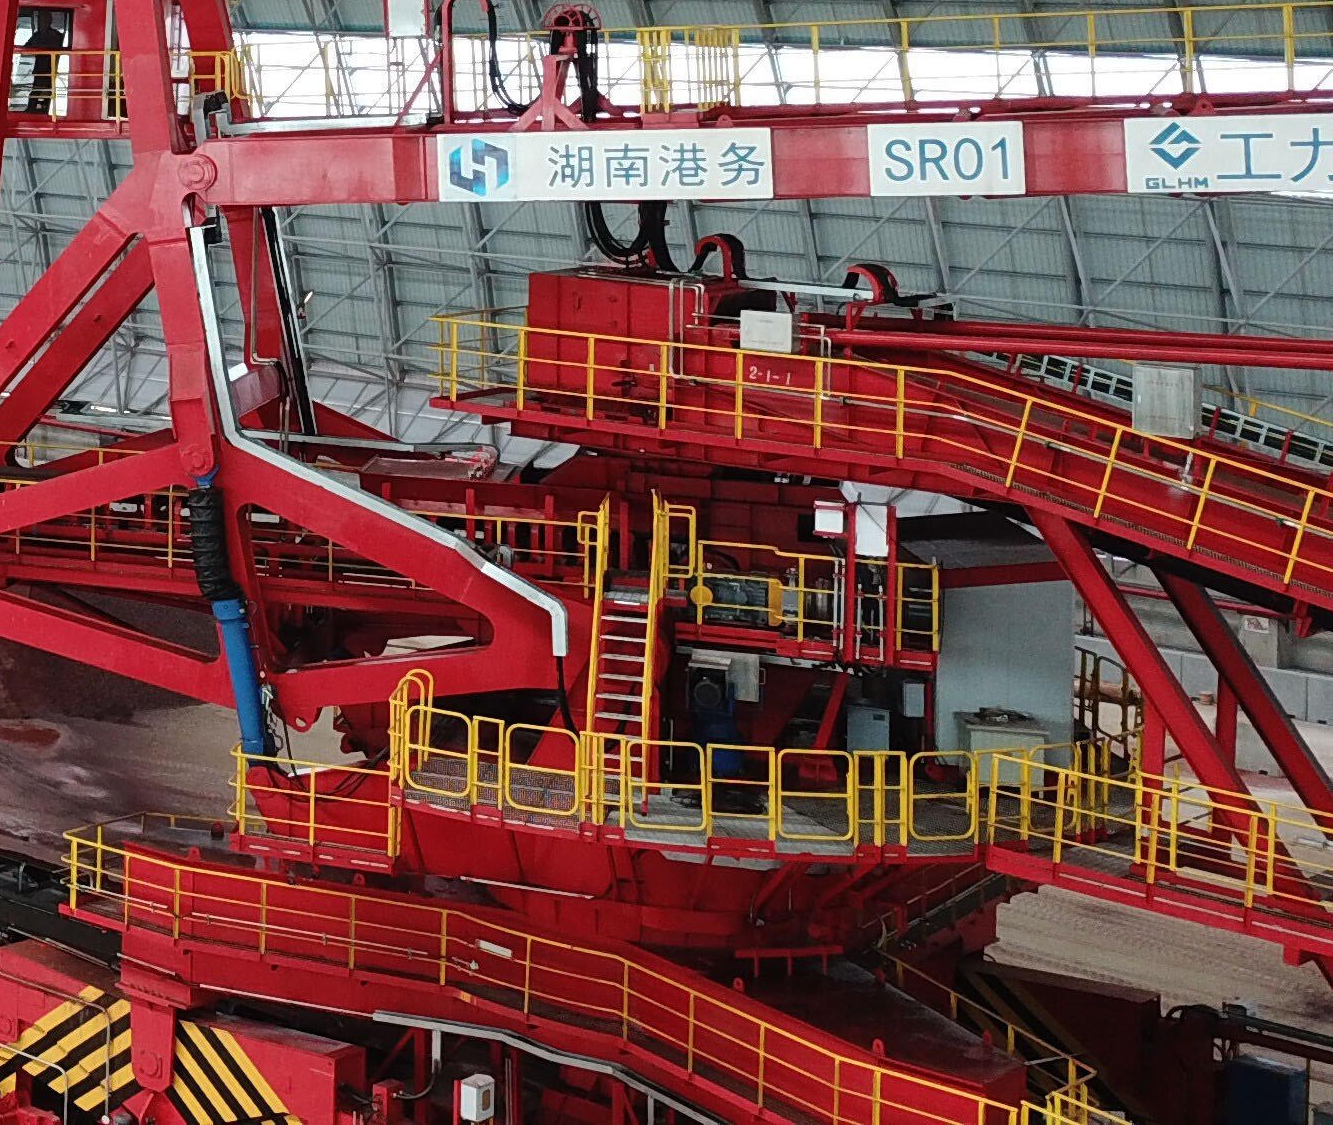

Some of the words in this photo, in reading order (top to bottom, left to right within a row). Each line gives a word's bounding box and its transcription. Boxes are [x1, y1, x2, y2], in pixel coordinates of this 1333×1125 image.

[547, 141, 766, 188] 湖南港务
[883, 136, 1011, 182] SR01
[1144, 176, 1209, 190] GLHM
[749, 366, 791, 385] 2-1-1
